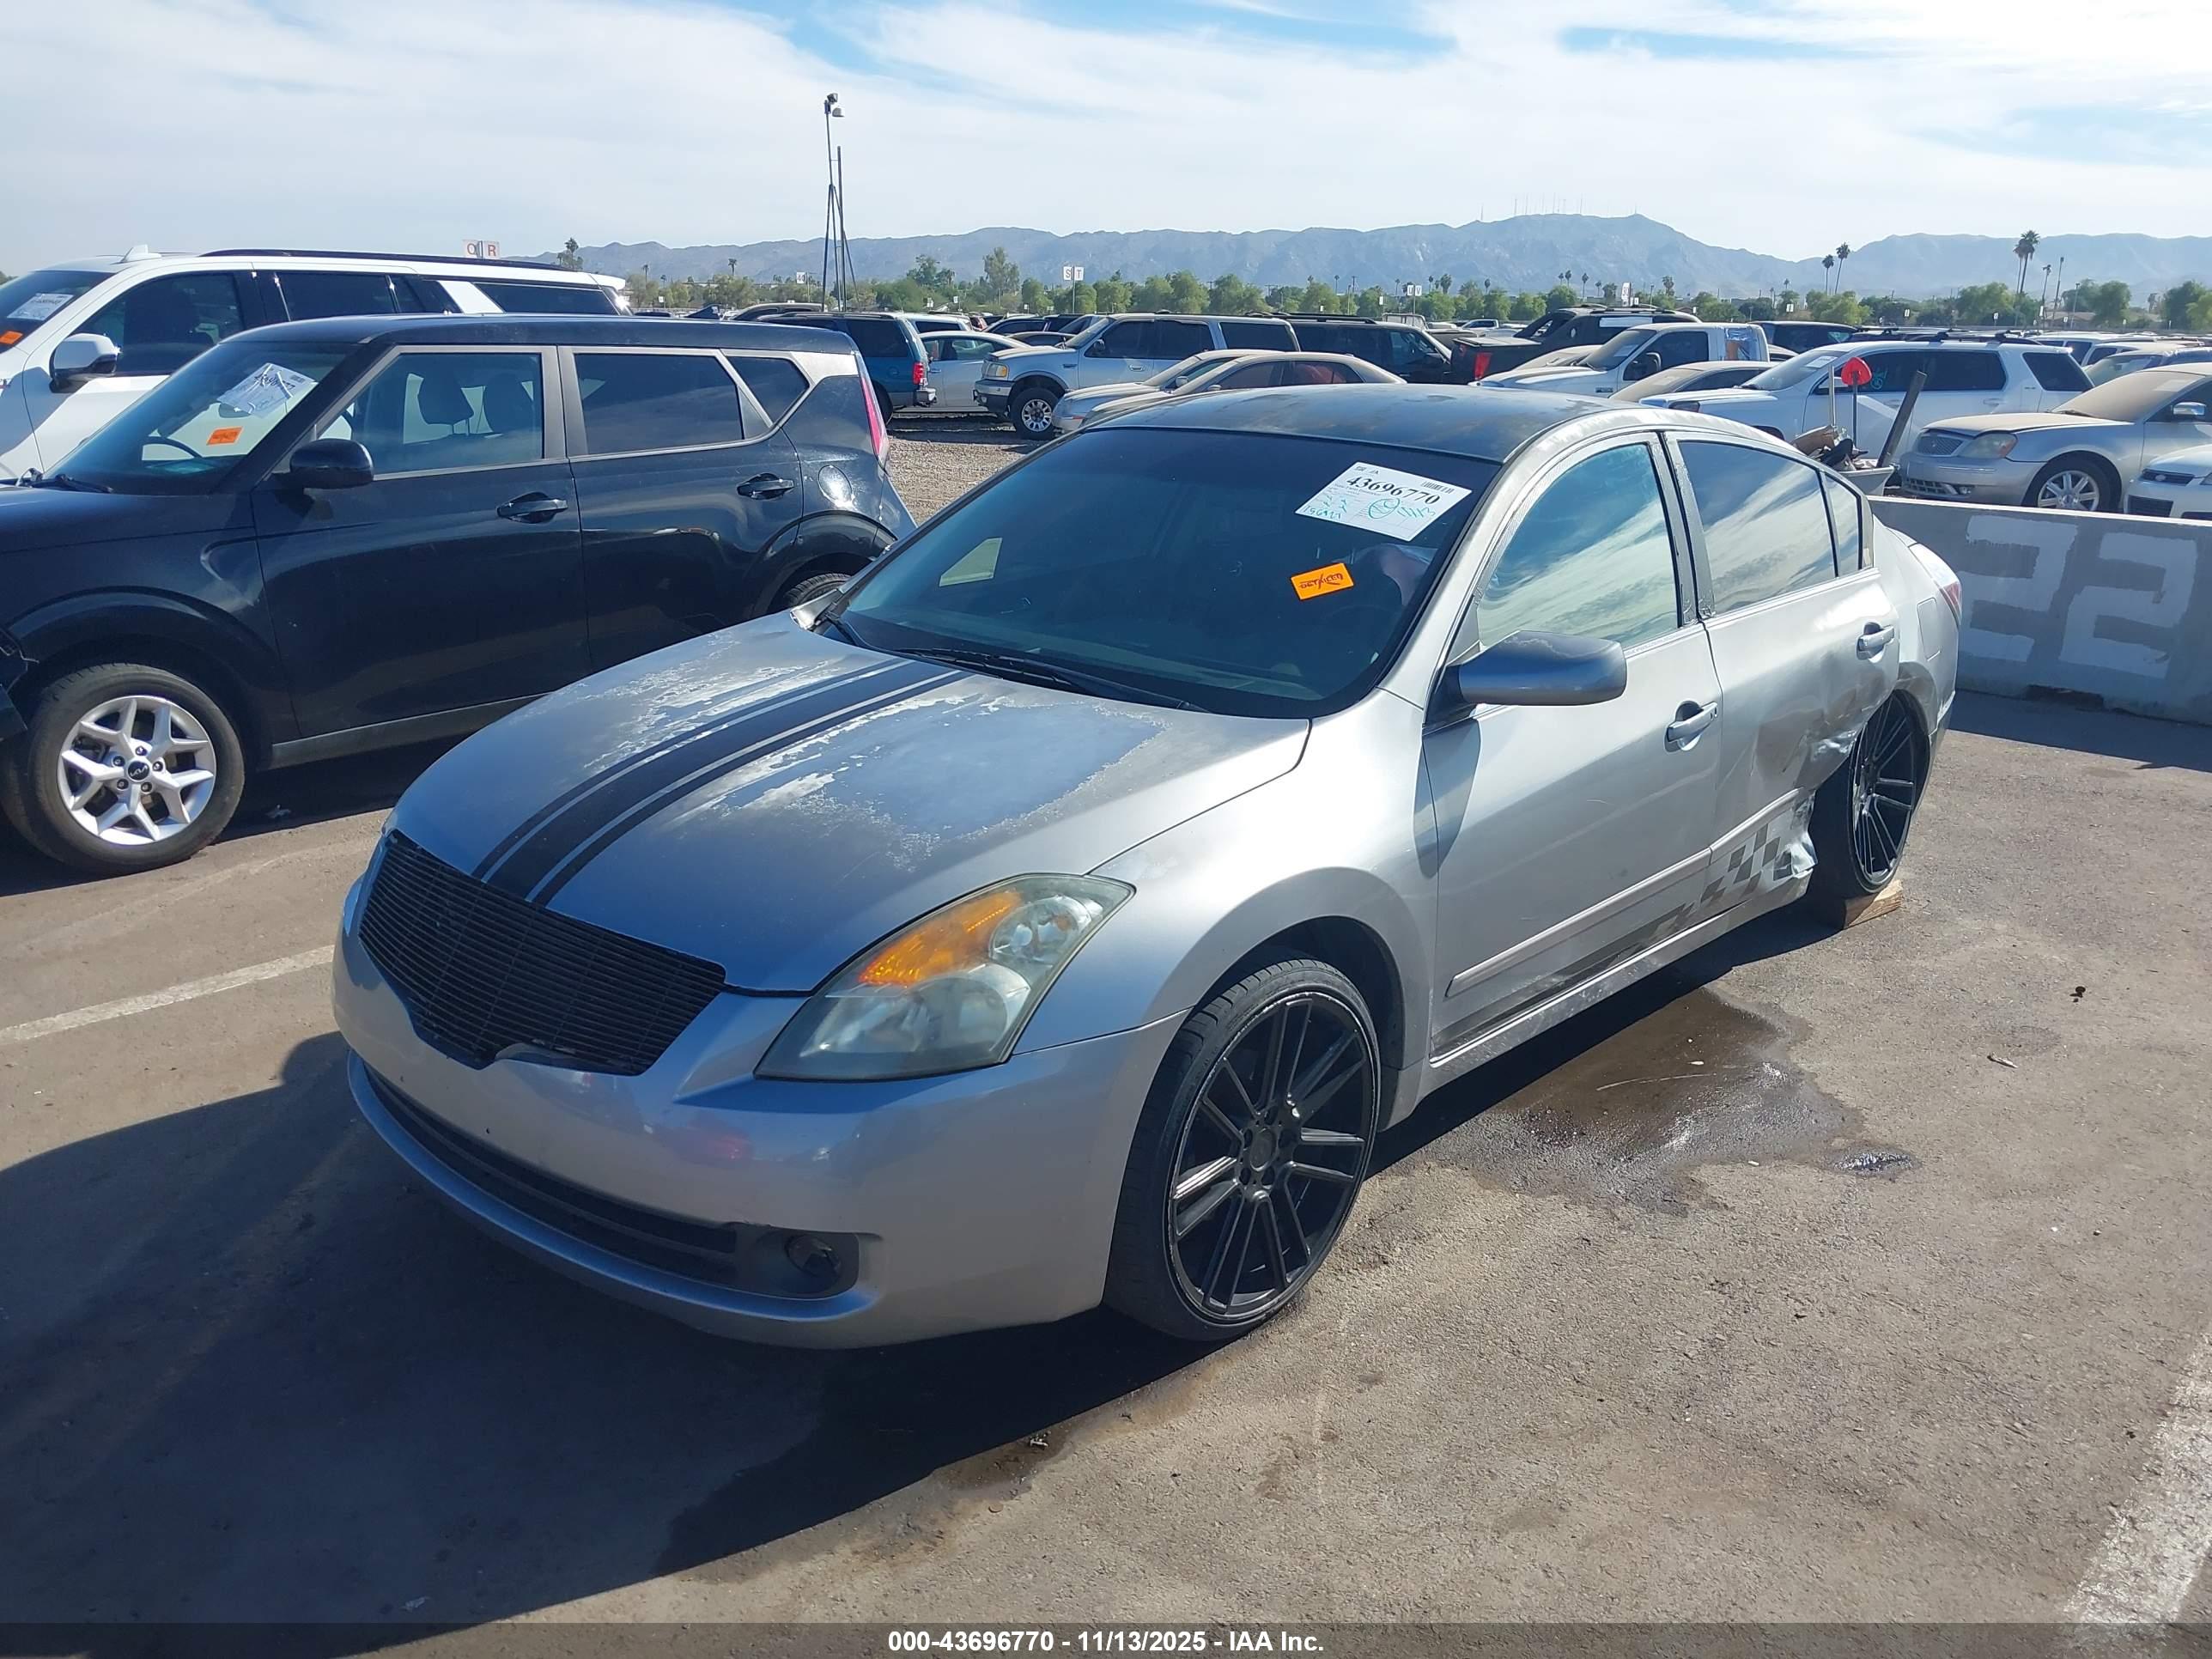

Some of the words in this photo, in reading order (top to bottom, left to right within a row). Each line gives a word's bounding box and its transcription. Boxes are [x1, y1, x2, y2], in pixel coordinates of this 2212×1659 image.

[487, 244, 496, 257] R
[1076, 270, 1082, 279] T
[1346, 476, 1440, 505] 43696770
